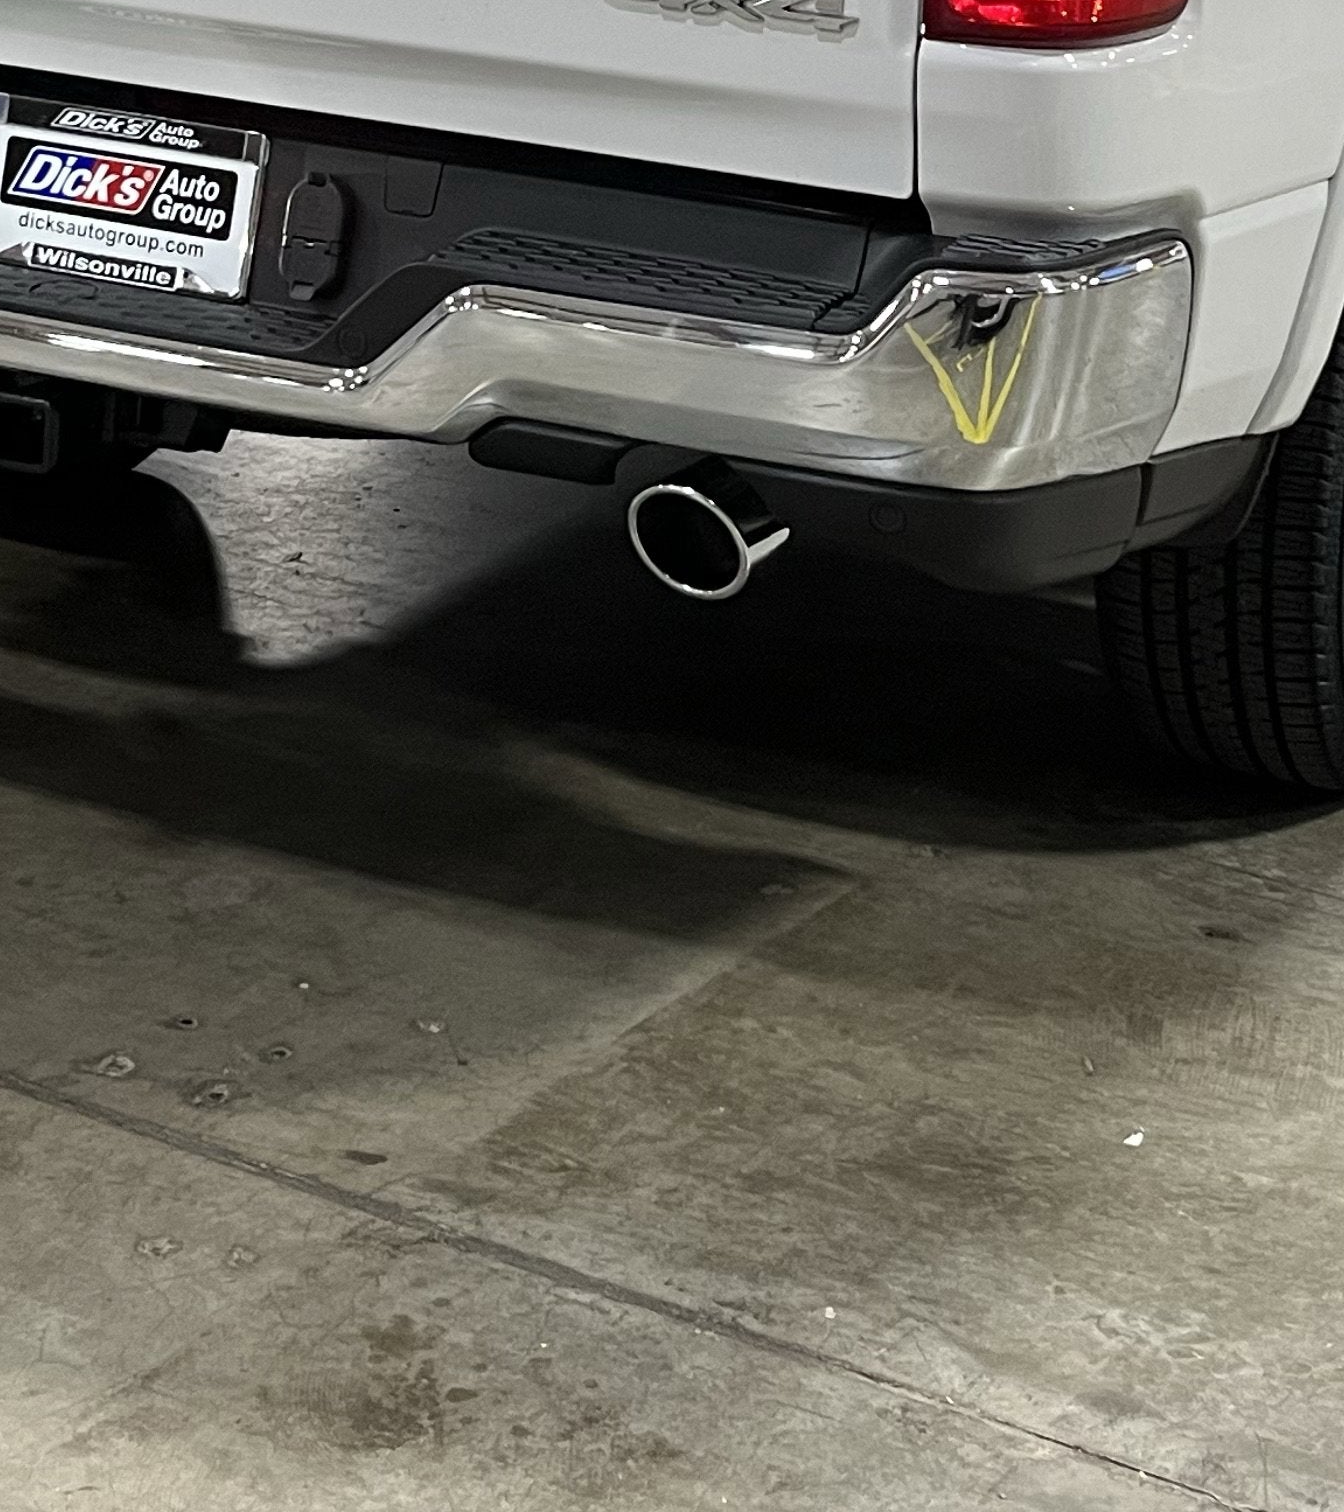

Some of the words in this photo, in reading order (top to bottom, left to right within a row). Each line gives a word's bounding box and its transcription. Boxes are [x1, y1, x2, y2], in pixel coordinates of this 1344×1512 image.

[58, 110, 143, 136] Dick's
[157, 122, 194, 137] Auto
[149, 132, 199, 149] Group
[19, 153, 146, 207] Dick's
[159, 169, 220, 202] Auto
[18, 211, 204, 258] dicksautogroup.com
[152, 198, 226, 233] Group
[36, 245, 171, 286] Wilsonville
